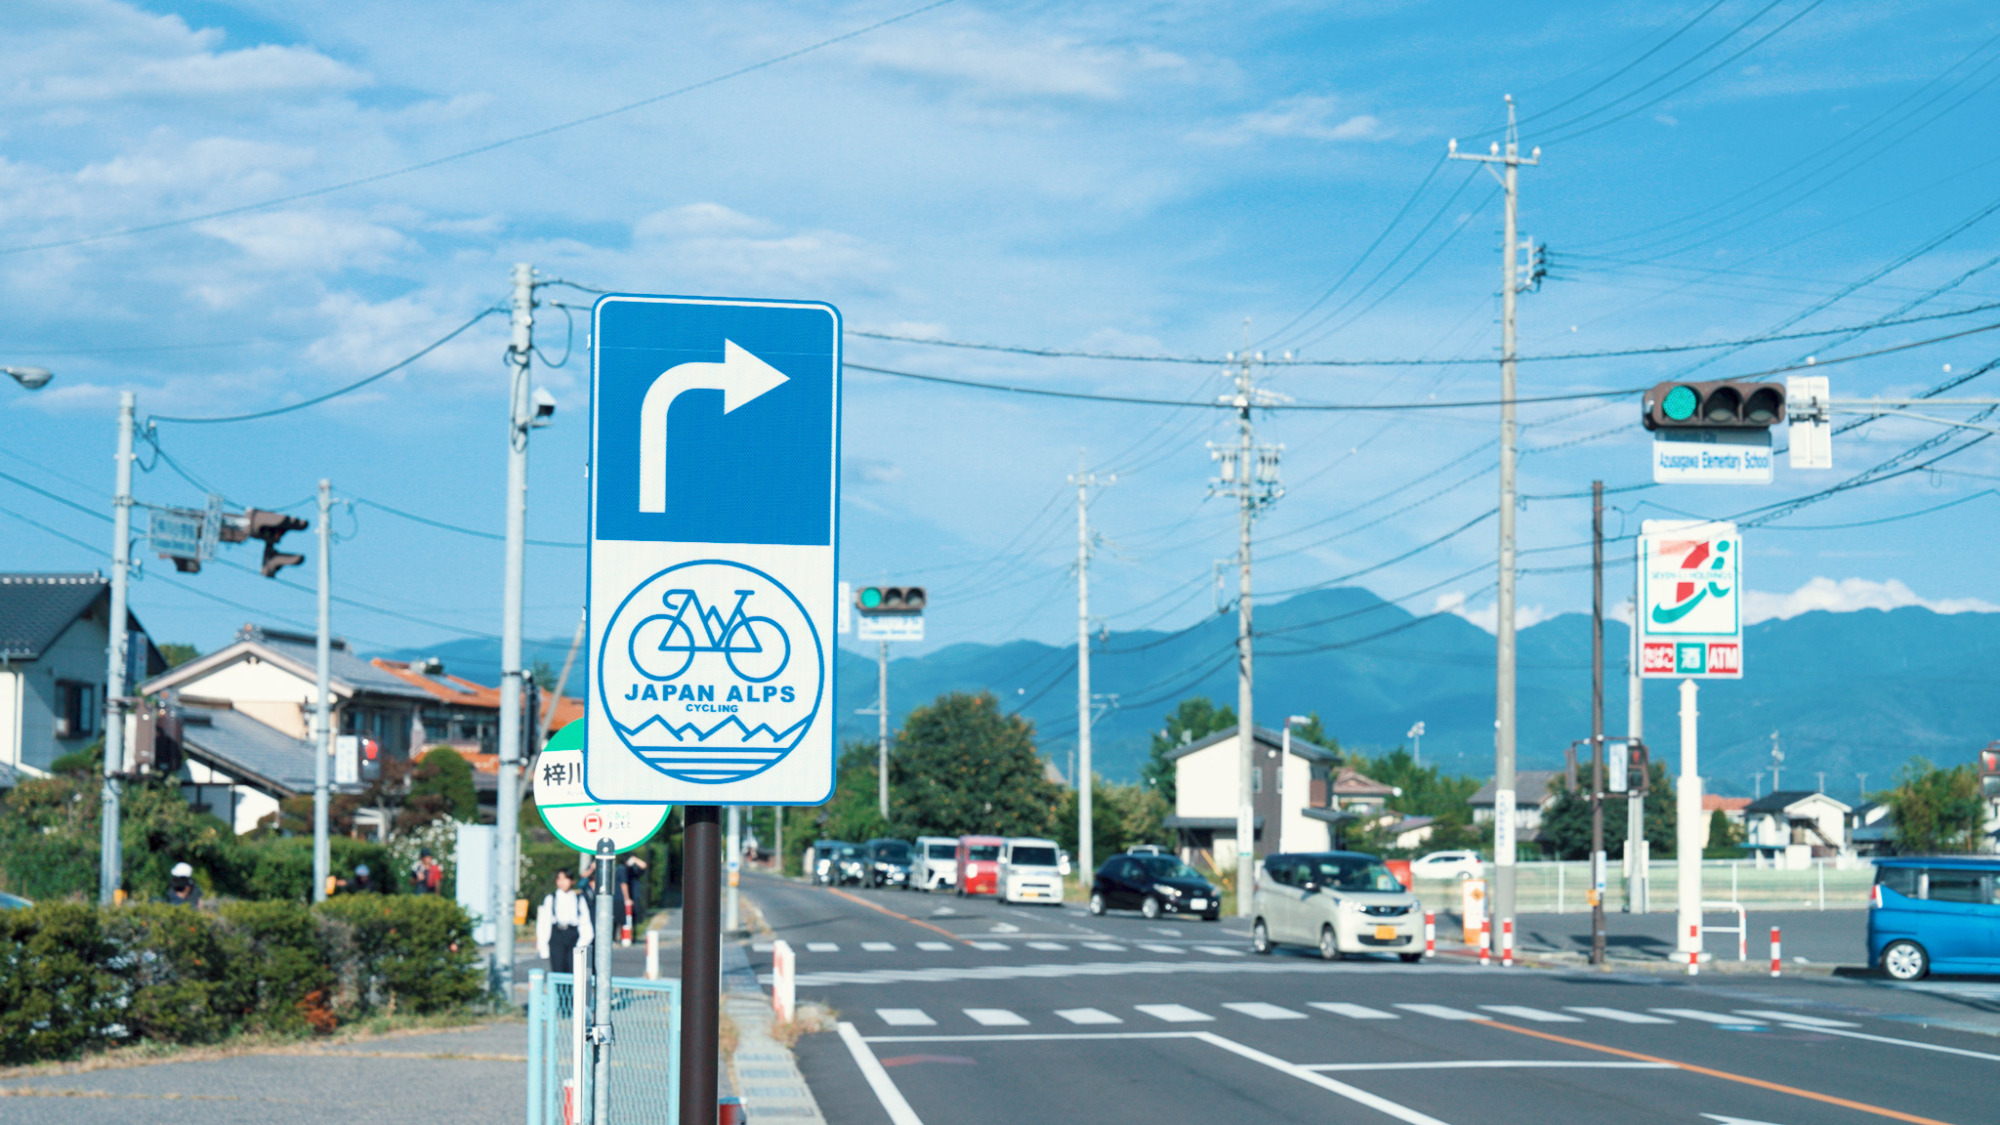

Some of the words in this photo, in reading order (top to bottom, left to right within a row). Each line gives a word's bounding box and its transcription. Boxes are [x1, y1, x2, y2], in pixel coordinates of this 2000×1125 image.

[1660, 452, 1699, 471] Azusagawa
[1702, 452, 1741, 472] Elementary
[1745, 452, 1769, 469] School
[1709, 647, 1738, 669] ATM
[625, 683, 715, 702] JAPAN
[726, 685, 796, 703] ALPS
[685, 704, 739, 713] CYCLING
